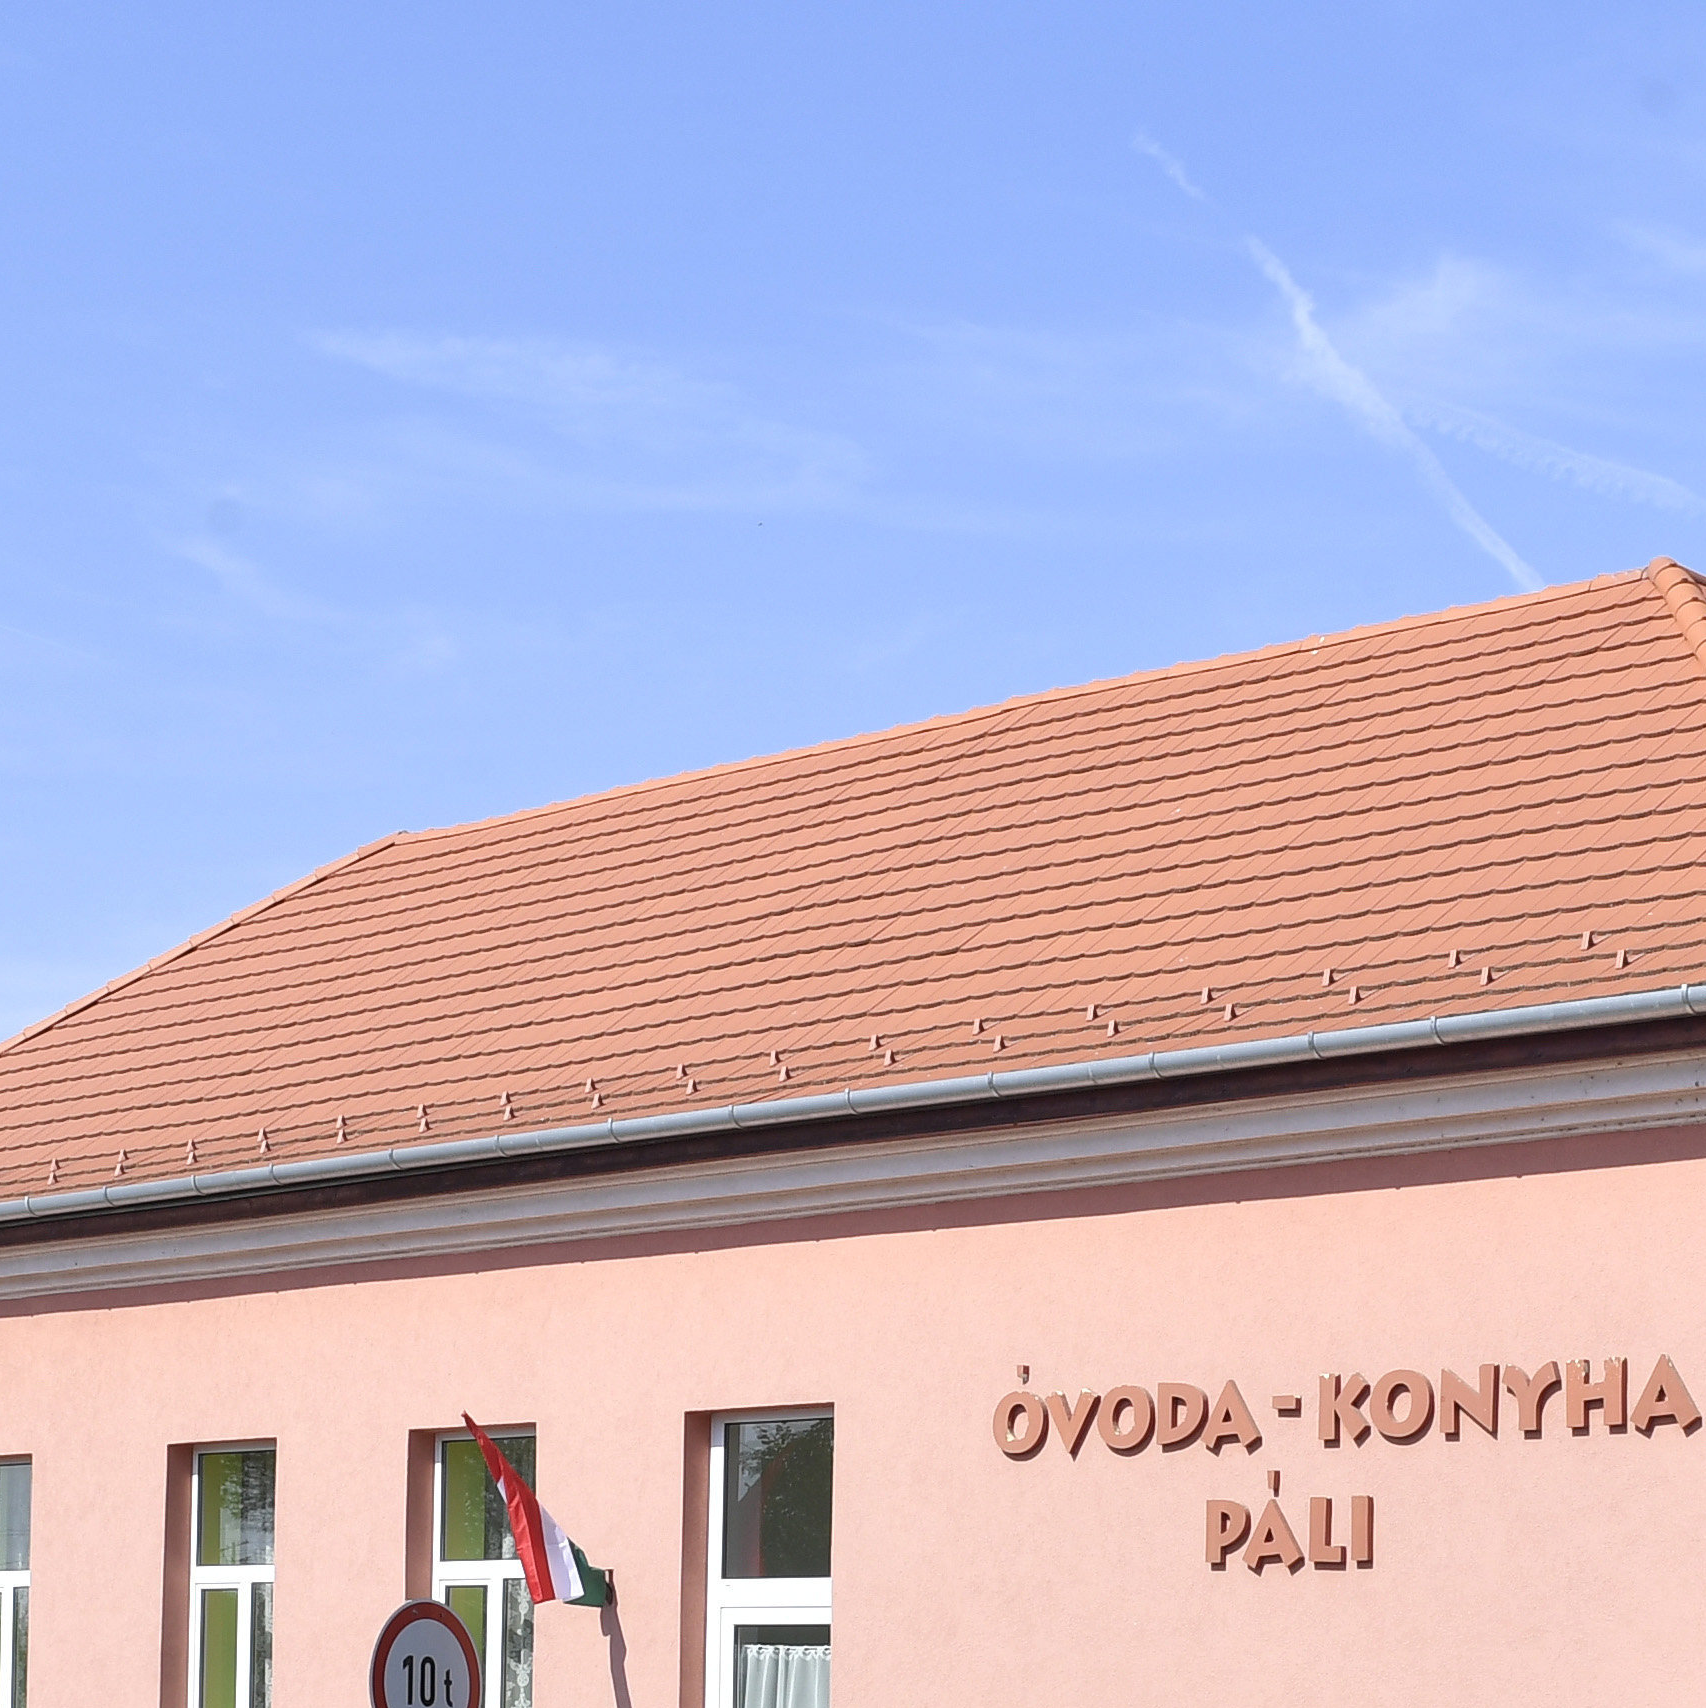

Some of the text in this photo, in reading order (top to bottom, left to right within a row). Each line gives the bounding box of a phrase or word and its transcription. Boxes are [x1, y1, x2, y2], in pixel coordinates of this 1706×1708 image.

[992, 1364, 1263, 1461] ÓVODA
[1318, 1353, 1703, 1448] KONYHA
[1205, 1470, 1374, 1575] PÁLI
[402, 1654, 454, 1708] 10 t
